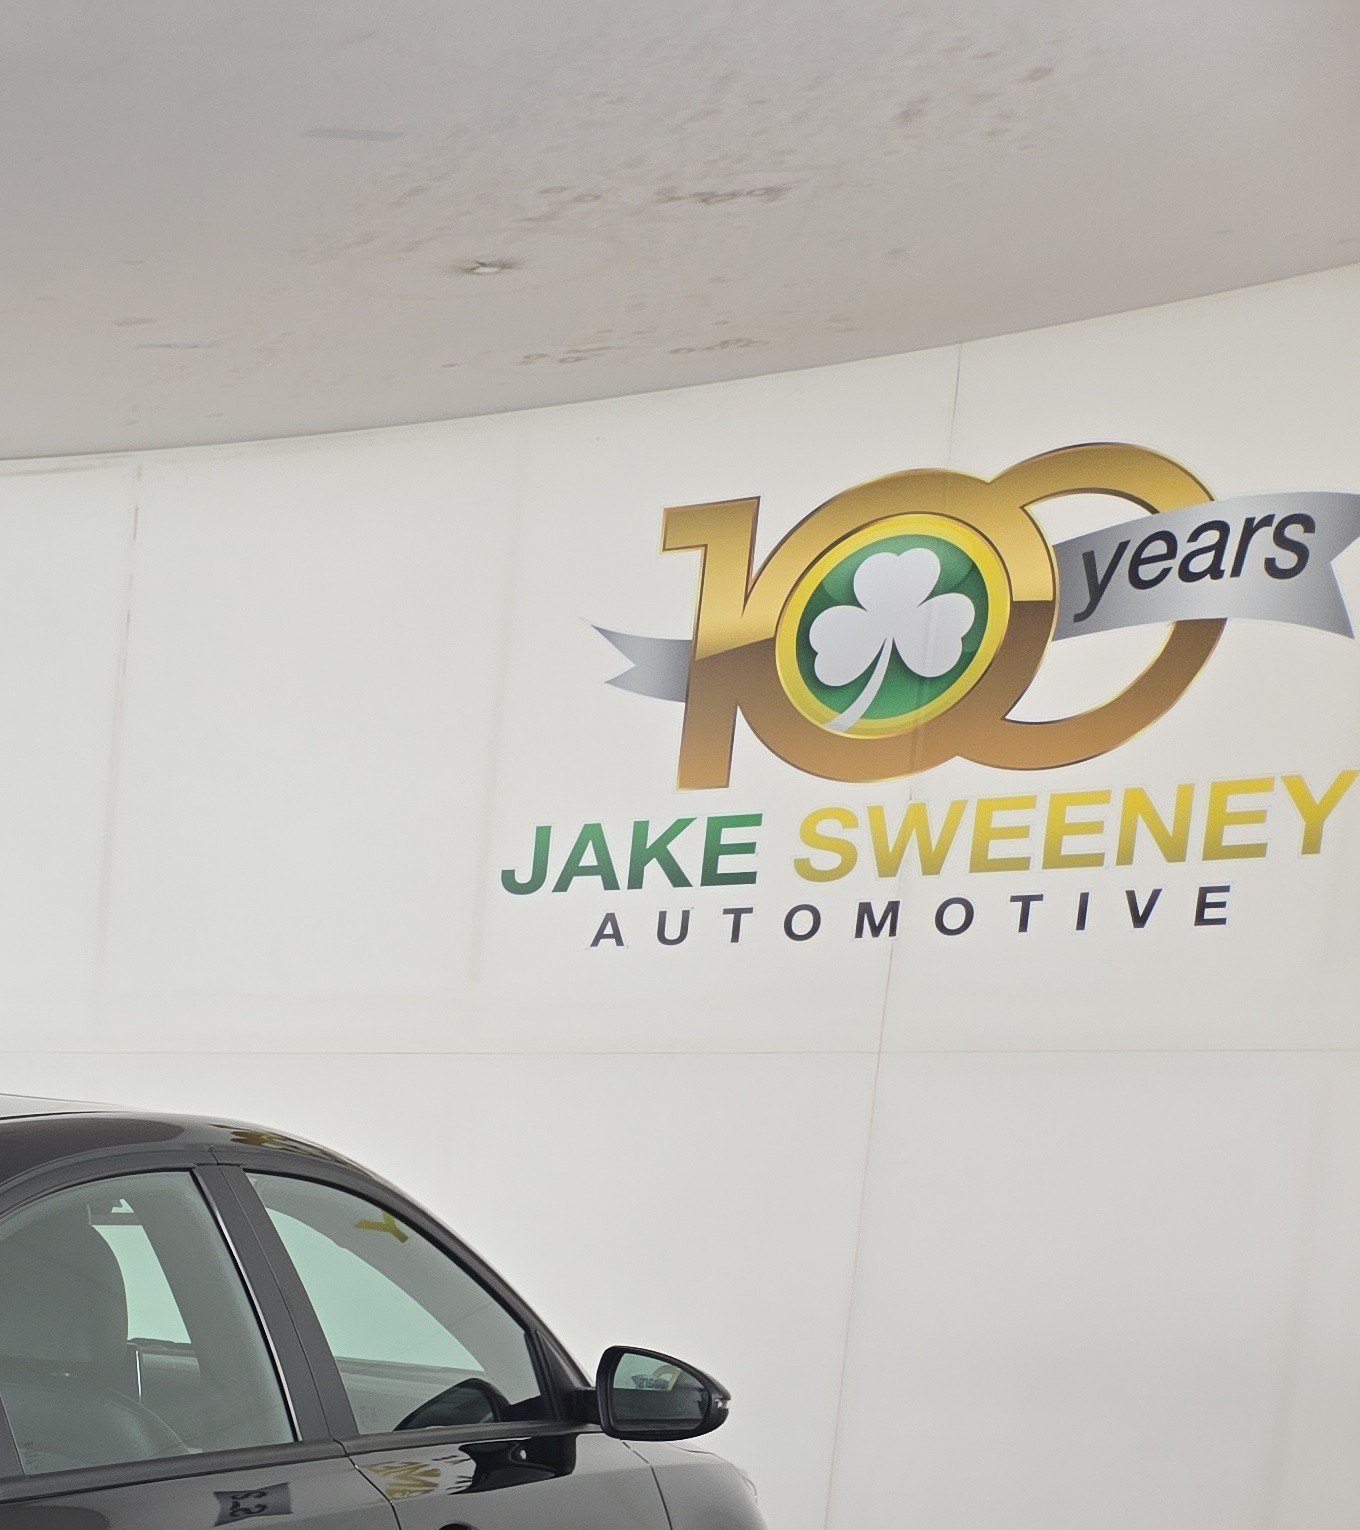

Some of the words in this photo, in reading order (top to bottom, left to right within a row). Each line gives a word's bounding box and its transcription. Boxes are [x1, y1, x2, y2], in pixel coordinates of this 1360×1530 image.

[662, 442, 1227, 789] 100
[1073, 513, 1316, 623] years
[501, 812, 763, 896] JAKE
[793, 769, 1360, 883] SWEENEY
[591, 885, 1232, 948] AUTOMOTIVE
